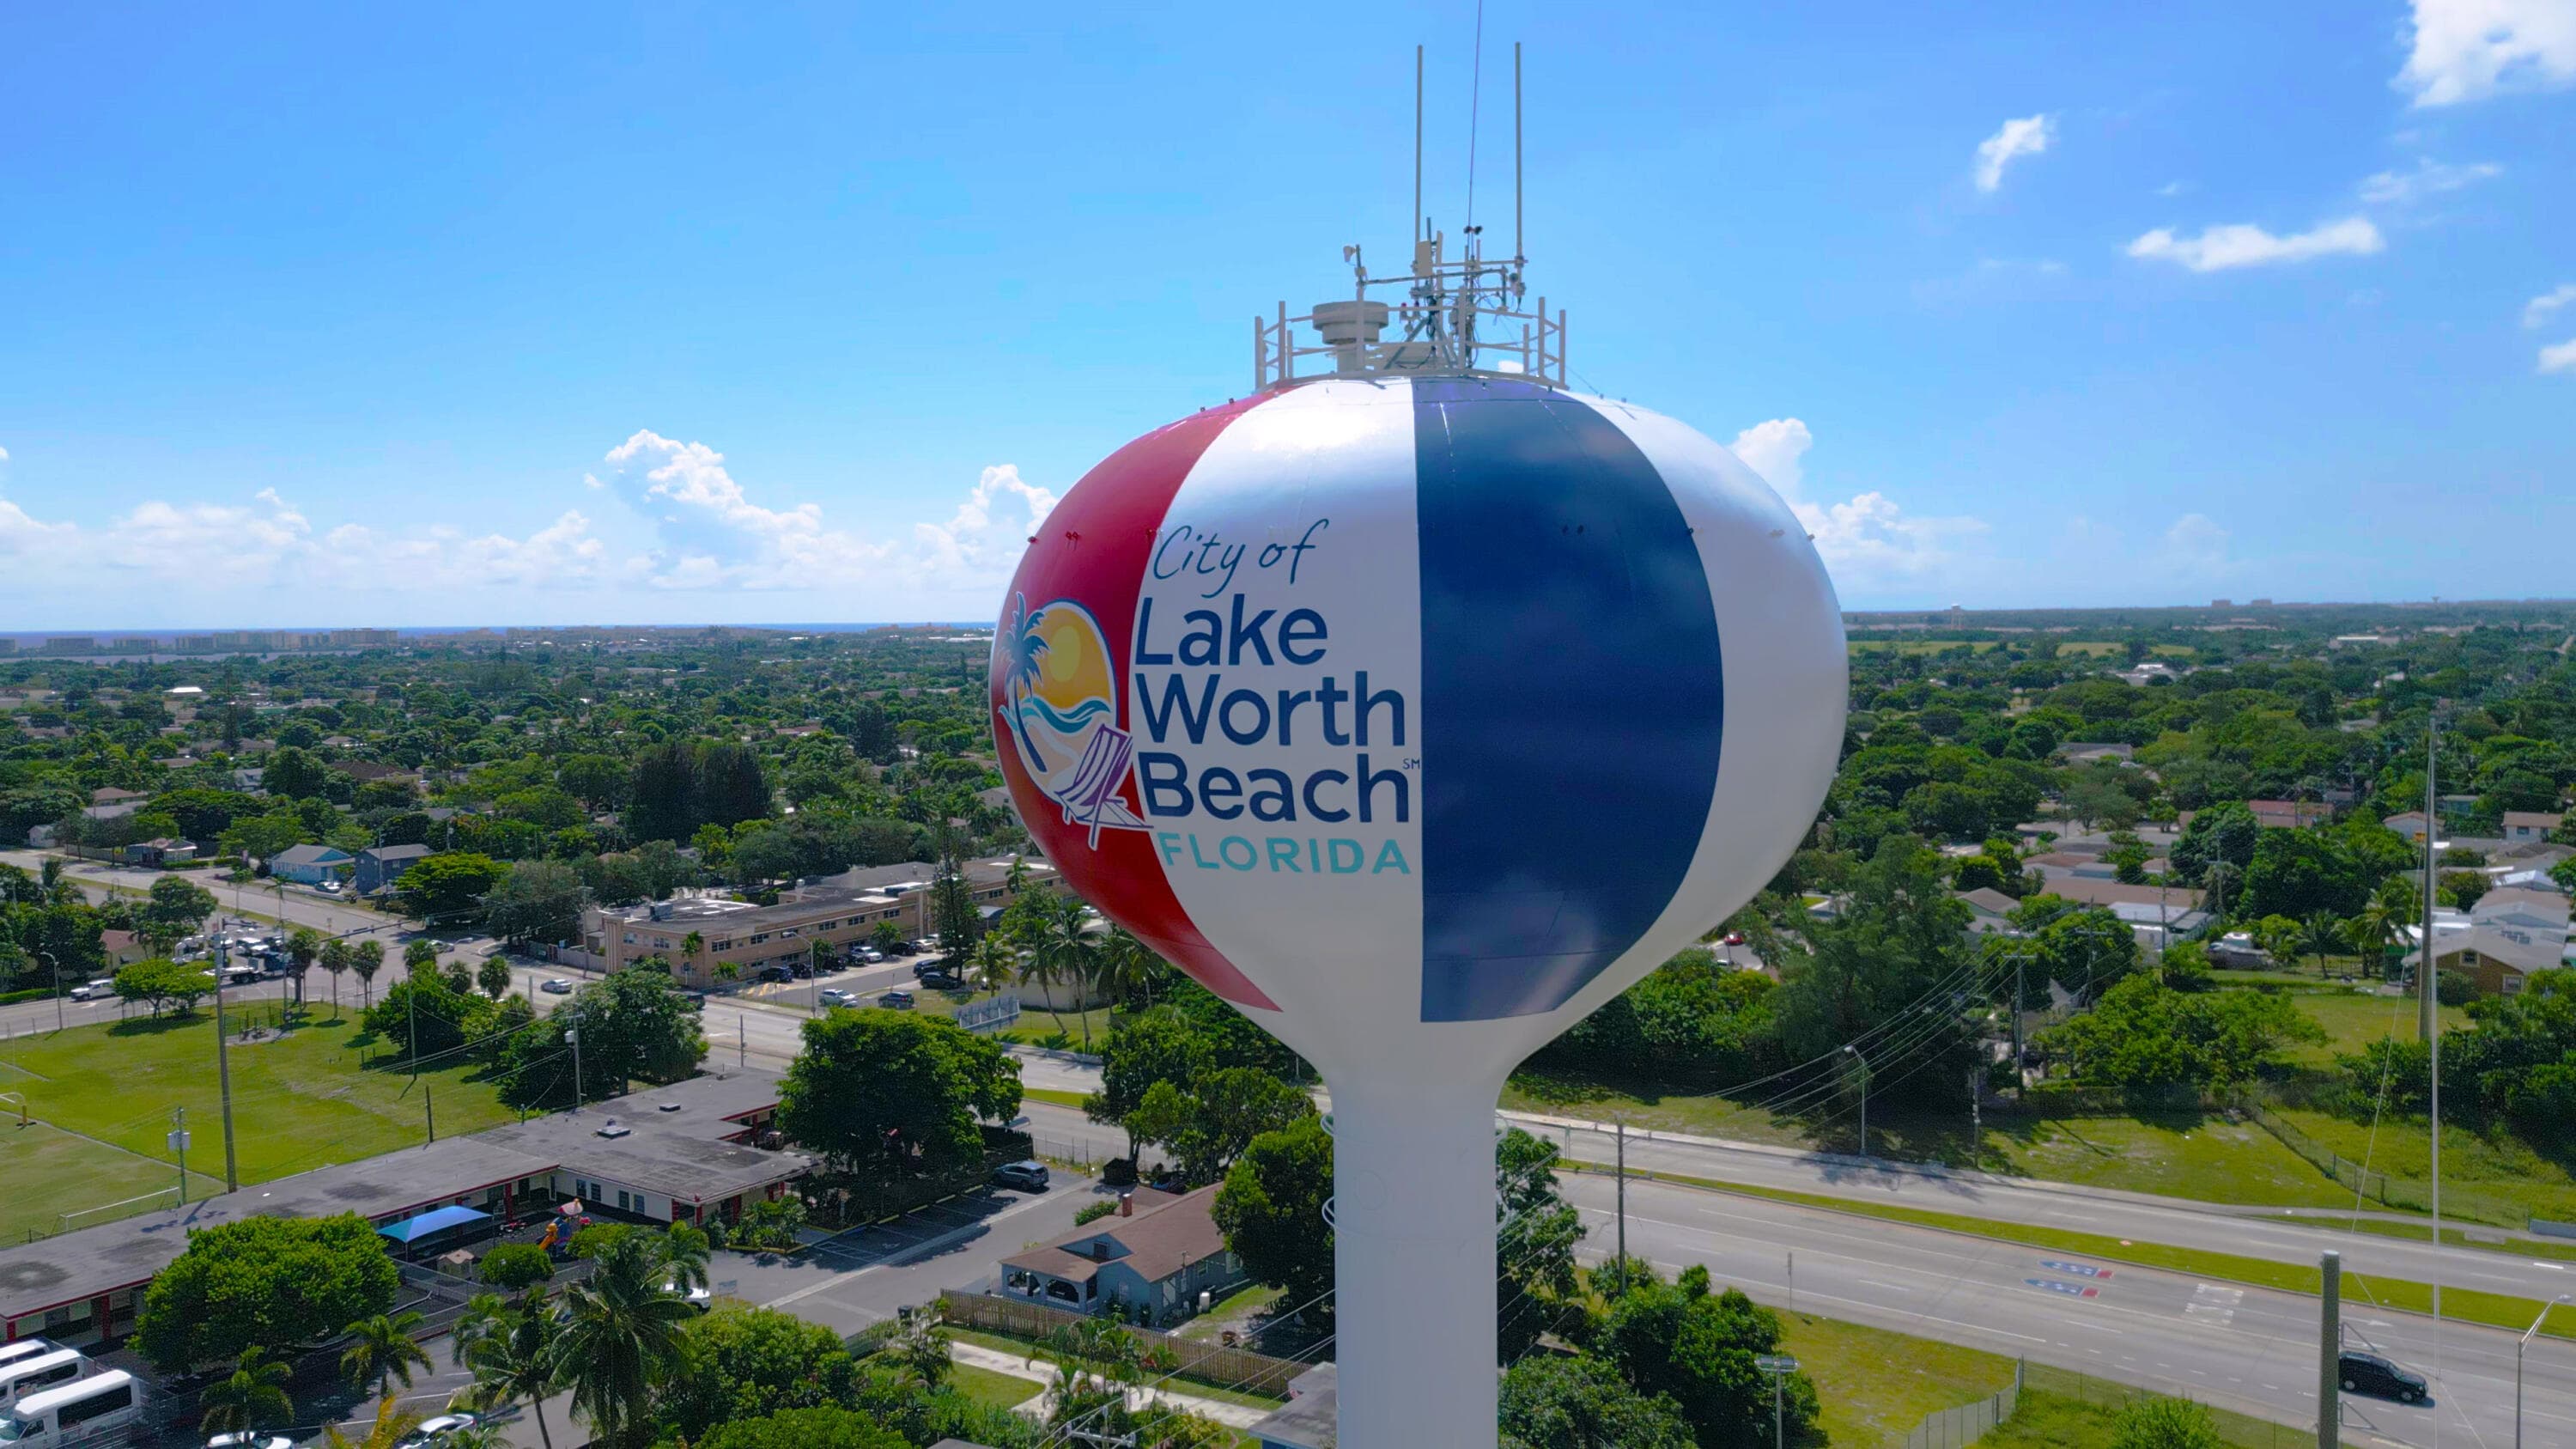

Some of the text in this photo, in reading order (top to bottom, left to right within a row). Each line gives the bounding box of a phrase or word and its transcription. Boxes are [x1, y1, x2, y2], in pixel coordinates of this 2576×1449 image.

[1153, 518, 1330, 599] City of
[1134, 593, 1328, 667] Lake
[1134, 670, 1406, 746] Worth
[1137, 752, 1409, 824] Beach
[1401, 757, 1421, 770] SM
[1157, 831, 1412, 875] FLORIDA
